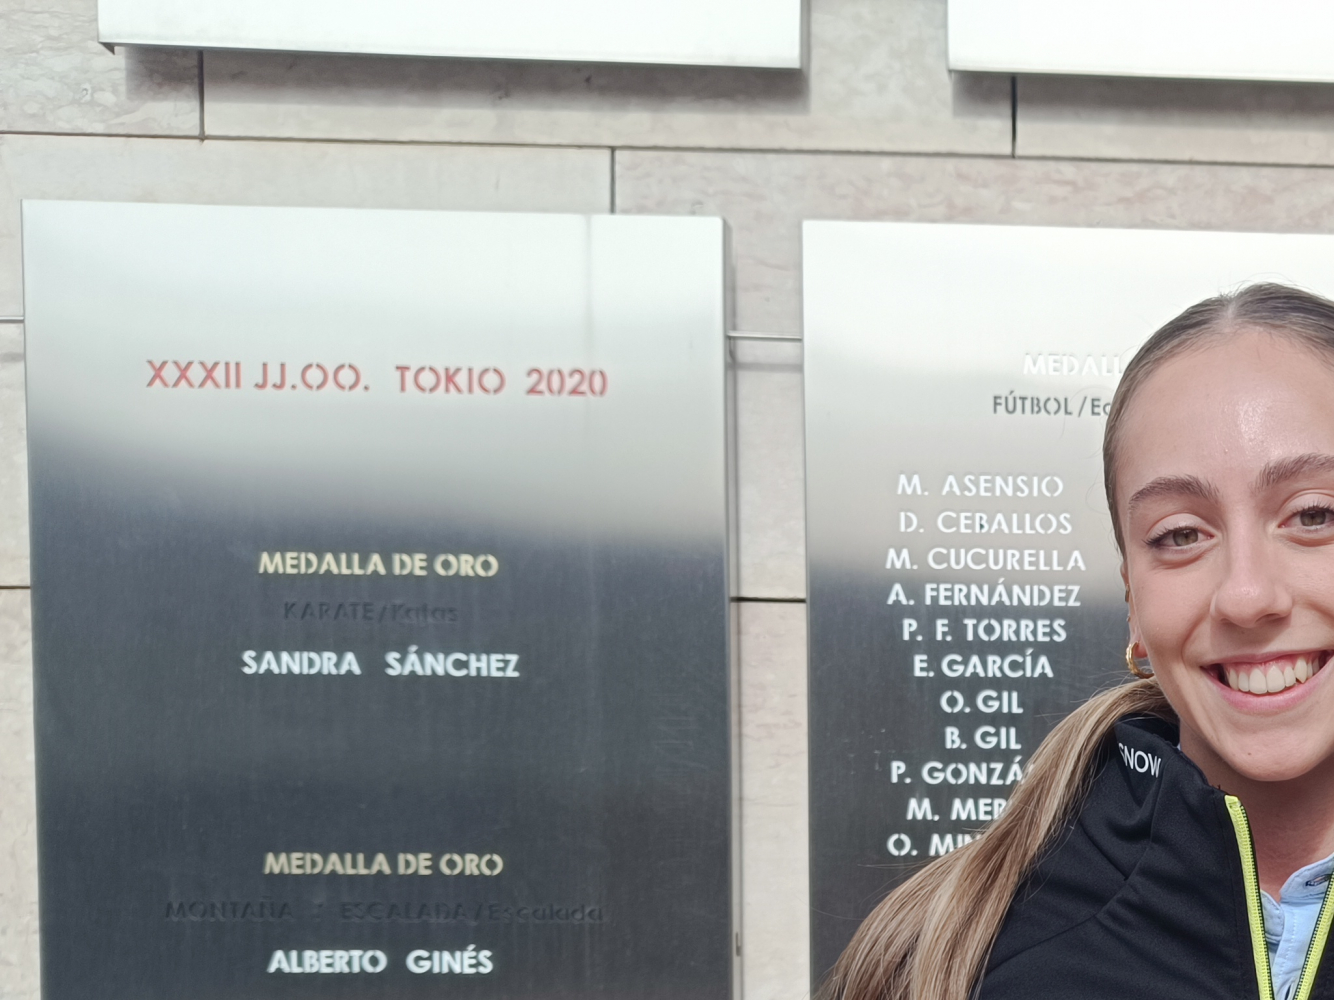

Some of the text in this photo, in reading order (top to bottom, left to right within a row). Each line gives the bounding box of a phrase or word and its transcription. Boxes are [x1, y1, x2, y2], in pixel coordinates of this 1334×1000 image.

[147, 360, 607, 396] XXXII JJ.OO. TOKIO 2020
[897, 475, 1063, 497] M. ASENSIO
[900, 512, 1072, 534] D. CEBALLOS
[259, 552, 498, 577] MEDALLA DE ORO
[886, 548, 1086, 571] M. CUCURELLA
[887, 577, 1080, 609] A. FERNÁNDEZ
[903, 618, 1066, 642] P. F. TORRES
[242, 645, 519, 677] SANDRA SÁNCHEZ
[914, 649, 1053, 678] E. GARCÍA
[940, 690, 1023, 713] O. GIL
[945, 726, 1021, 749] B. GIL
[891, 756, 1025, 785] P. GONZÁ
[907, 798, 939, 820] M.
[887, 834, 917, 856] O.
[264, 852, 503, 875] MEDALLA DE ORO
[268, 944, 493, 974] ALBERTO GINÉS
